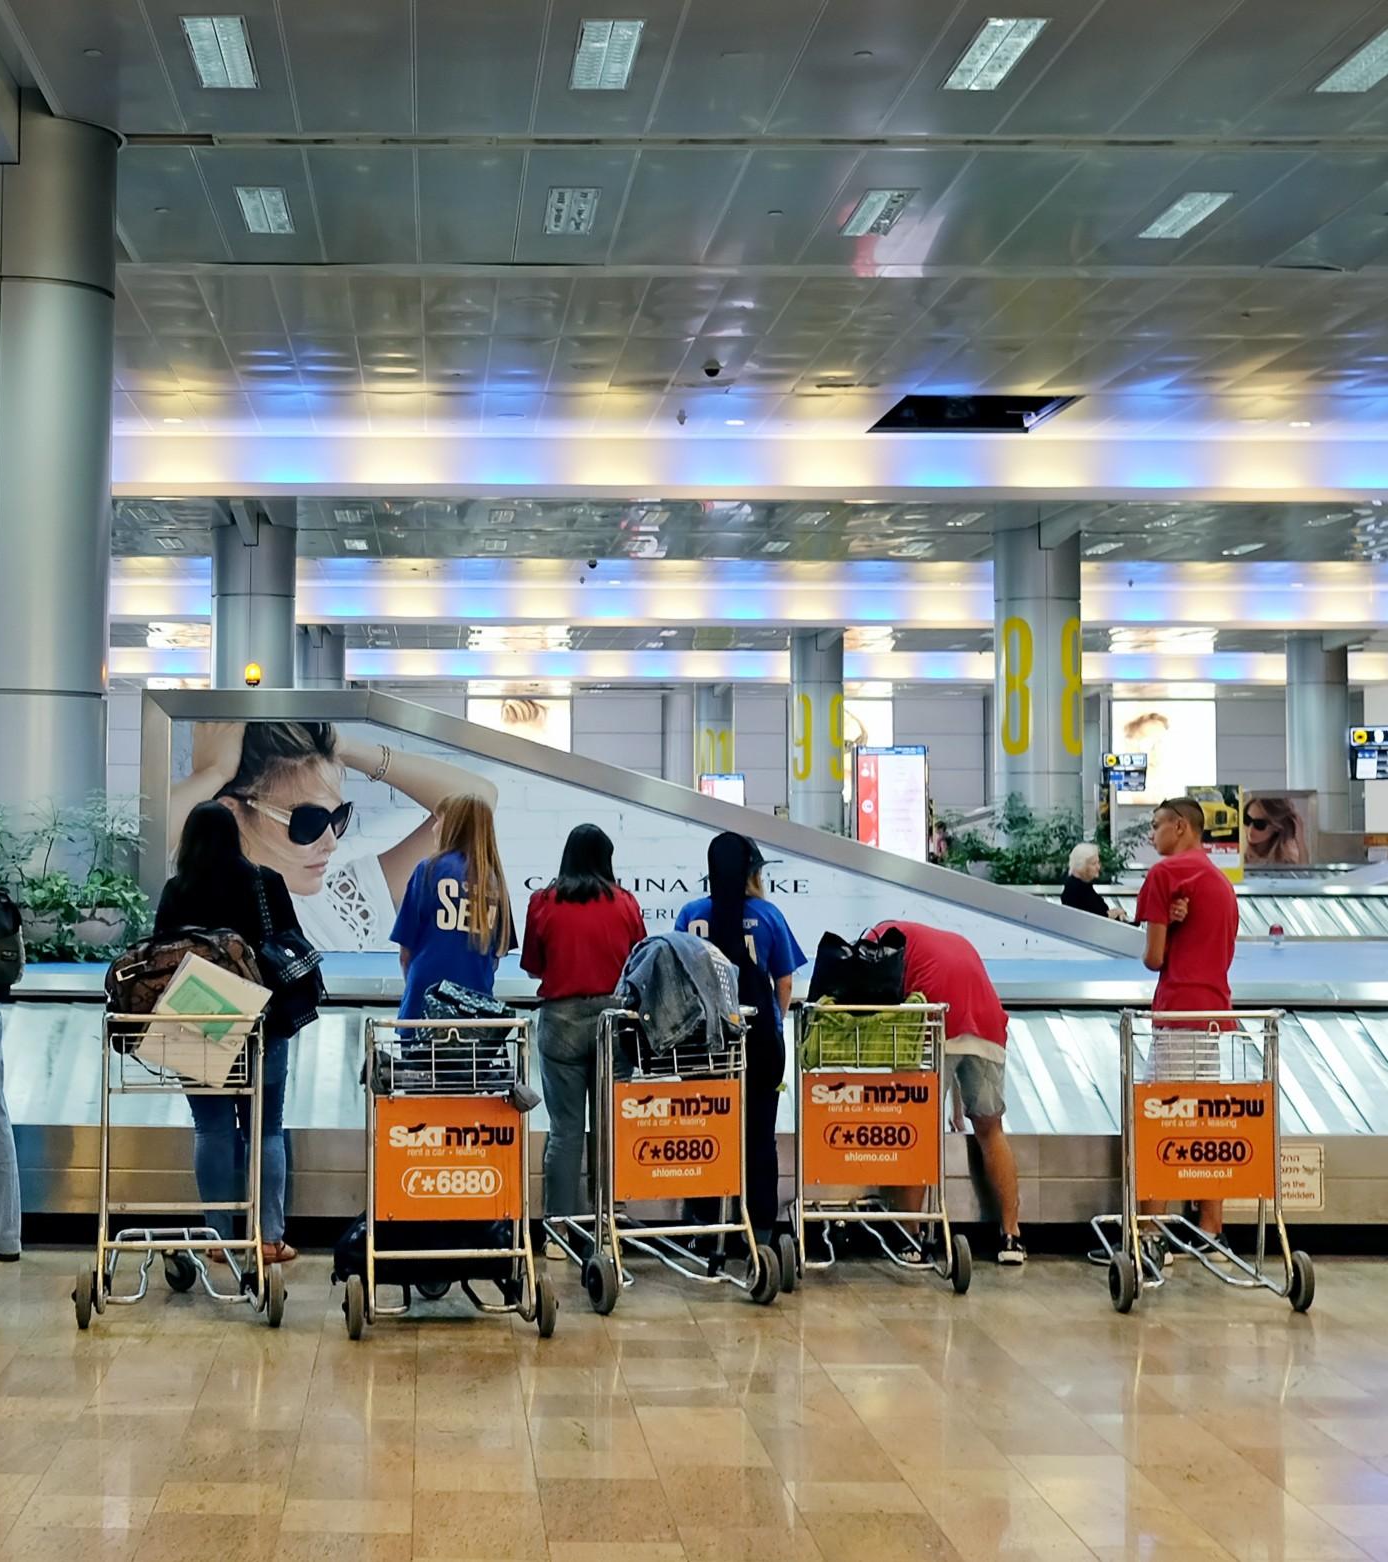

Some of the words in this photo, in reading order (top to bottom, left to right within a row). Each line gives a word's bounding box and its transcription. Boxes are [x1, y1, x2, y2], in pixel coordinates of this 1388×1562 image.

[1001, 616, 1033, 756] 8
[863, 1083, 929, 1104] שלמה
[670, 1095, 731, 1117] שלמה
[1197, 1097, 1265, 1118] שלמה
[445, 1124, 515, 1146] שלמה
[844, 1152, 898, 1162] shlomo.co.il
[652, 1167, 702, 1178] shlomo.co.il
[1178, 1168, 1233, 1178] shlomo.co.il
